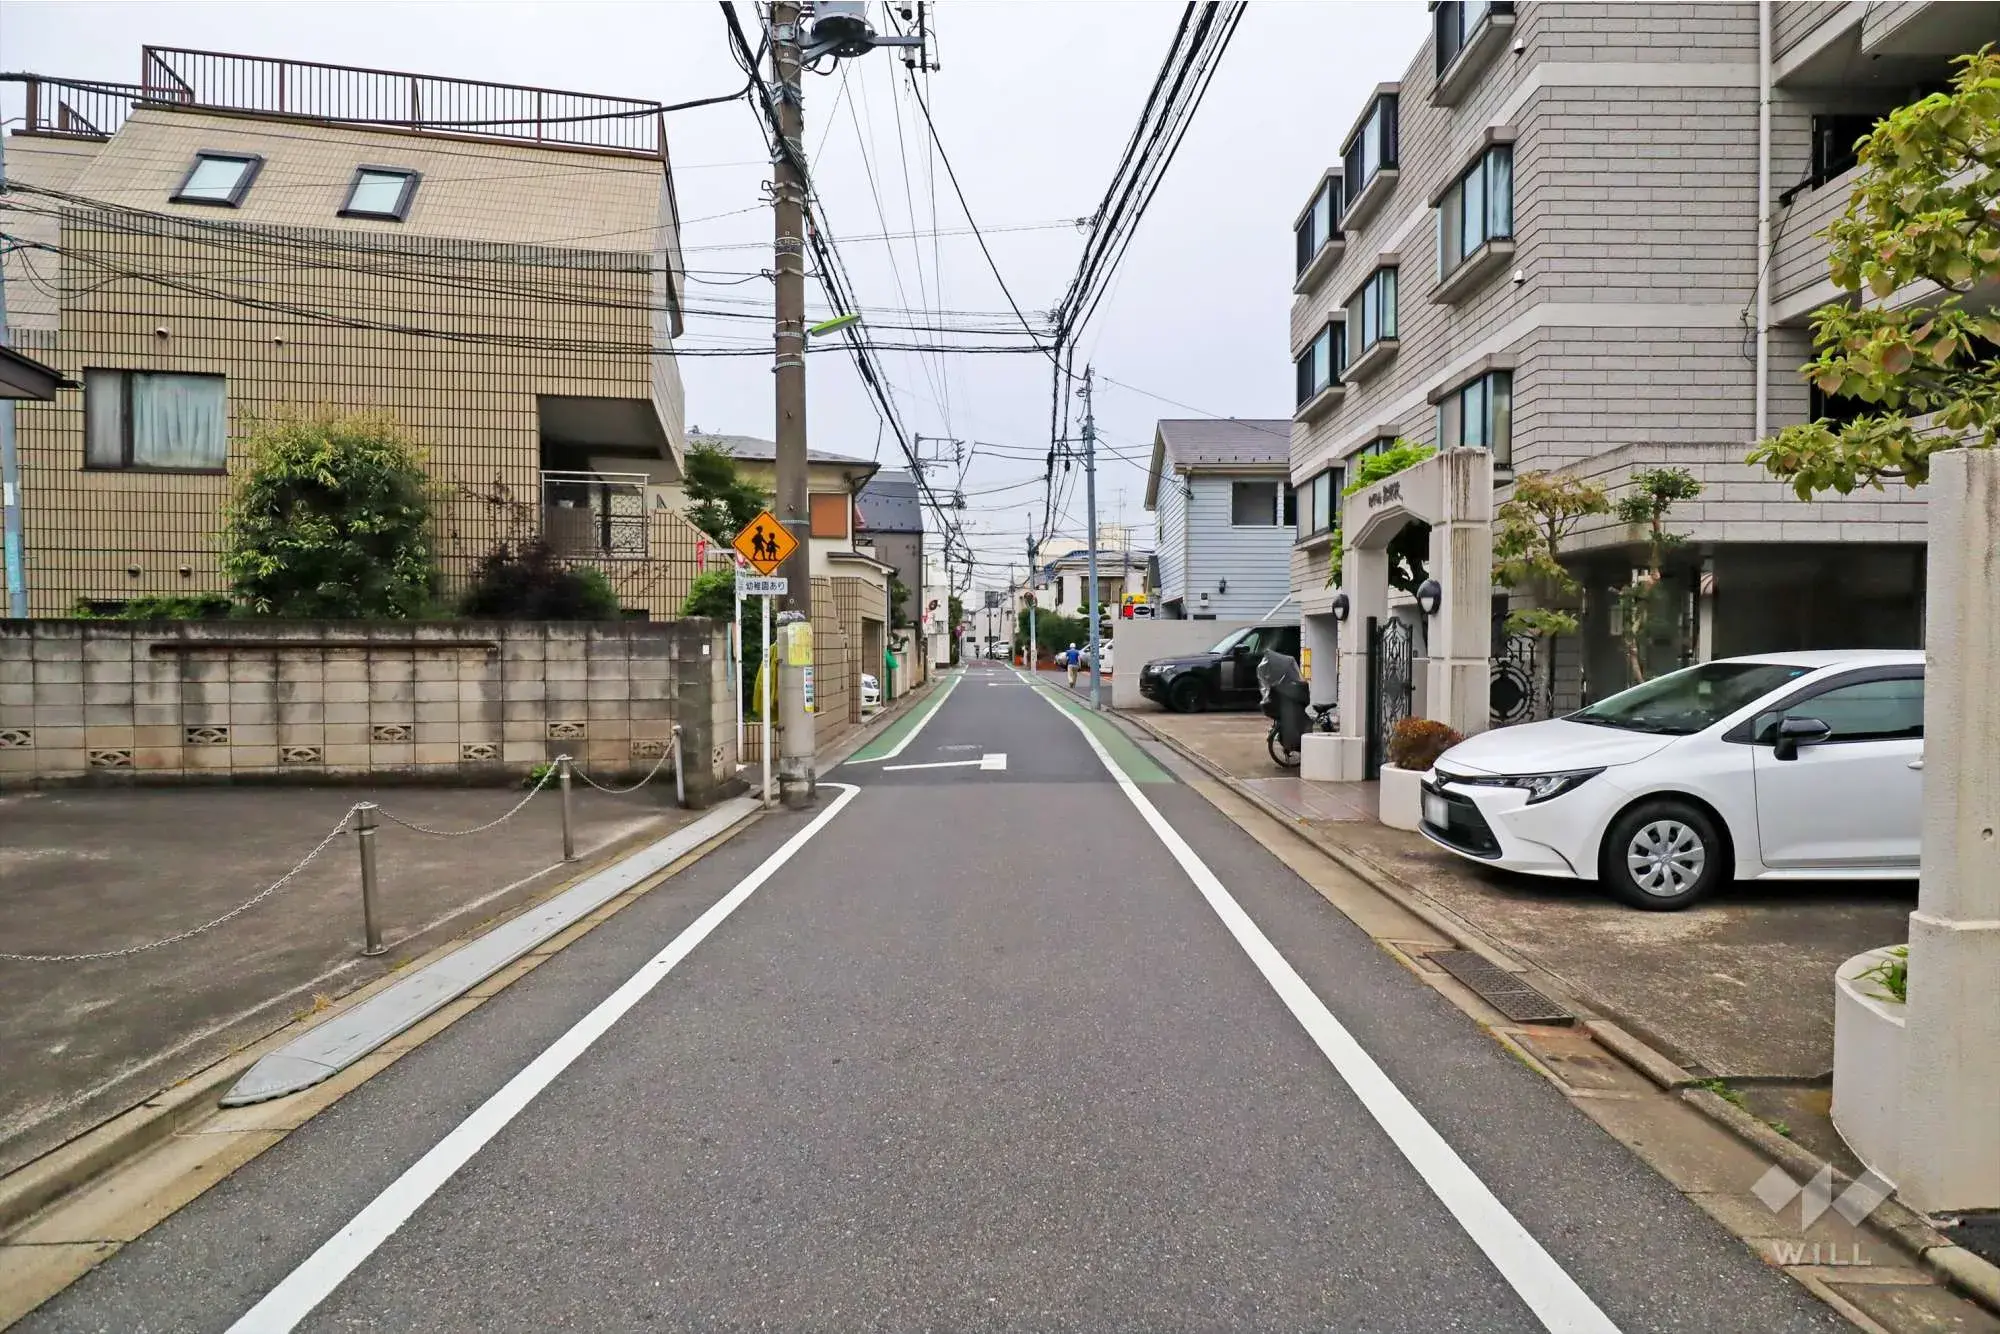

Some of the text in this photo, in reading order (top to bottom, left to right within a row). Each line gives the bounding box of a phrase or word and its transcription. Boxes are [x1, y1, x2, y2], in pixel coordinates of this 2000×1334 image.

[745, 581, 785, 591] 幼稚園あり
